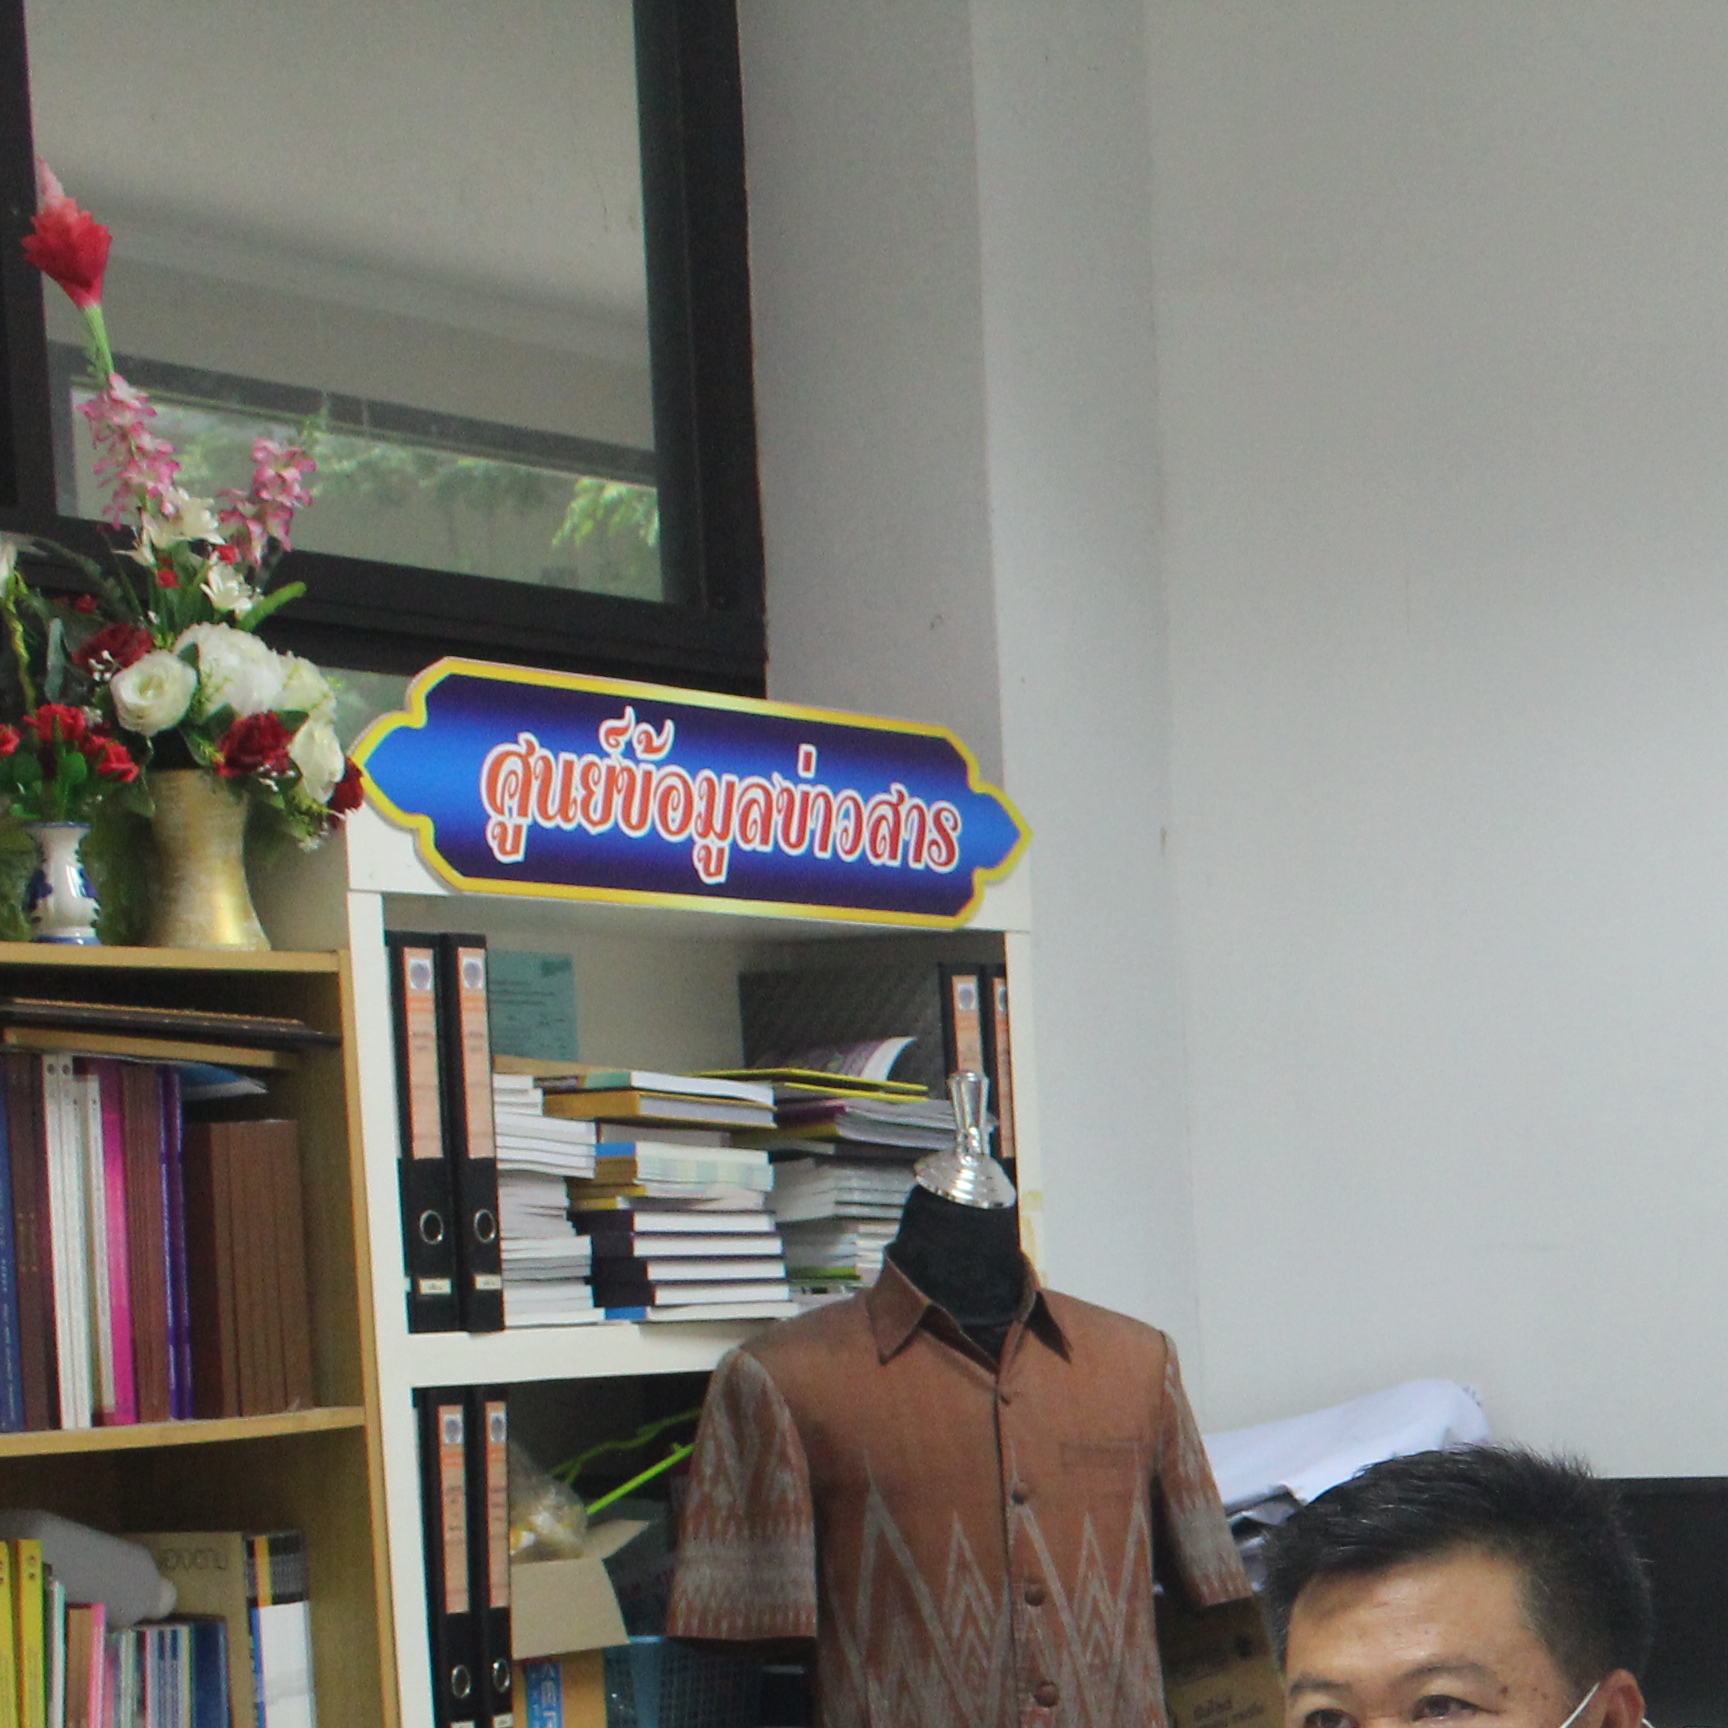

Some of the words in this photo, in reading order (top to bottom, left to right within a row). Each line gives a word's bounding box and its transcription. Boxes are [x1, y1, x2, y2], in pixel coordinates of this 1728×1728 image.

[480, 706, 961, 883] ศูนย์ข้อมูลข่าวสาร
